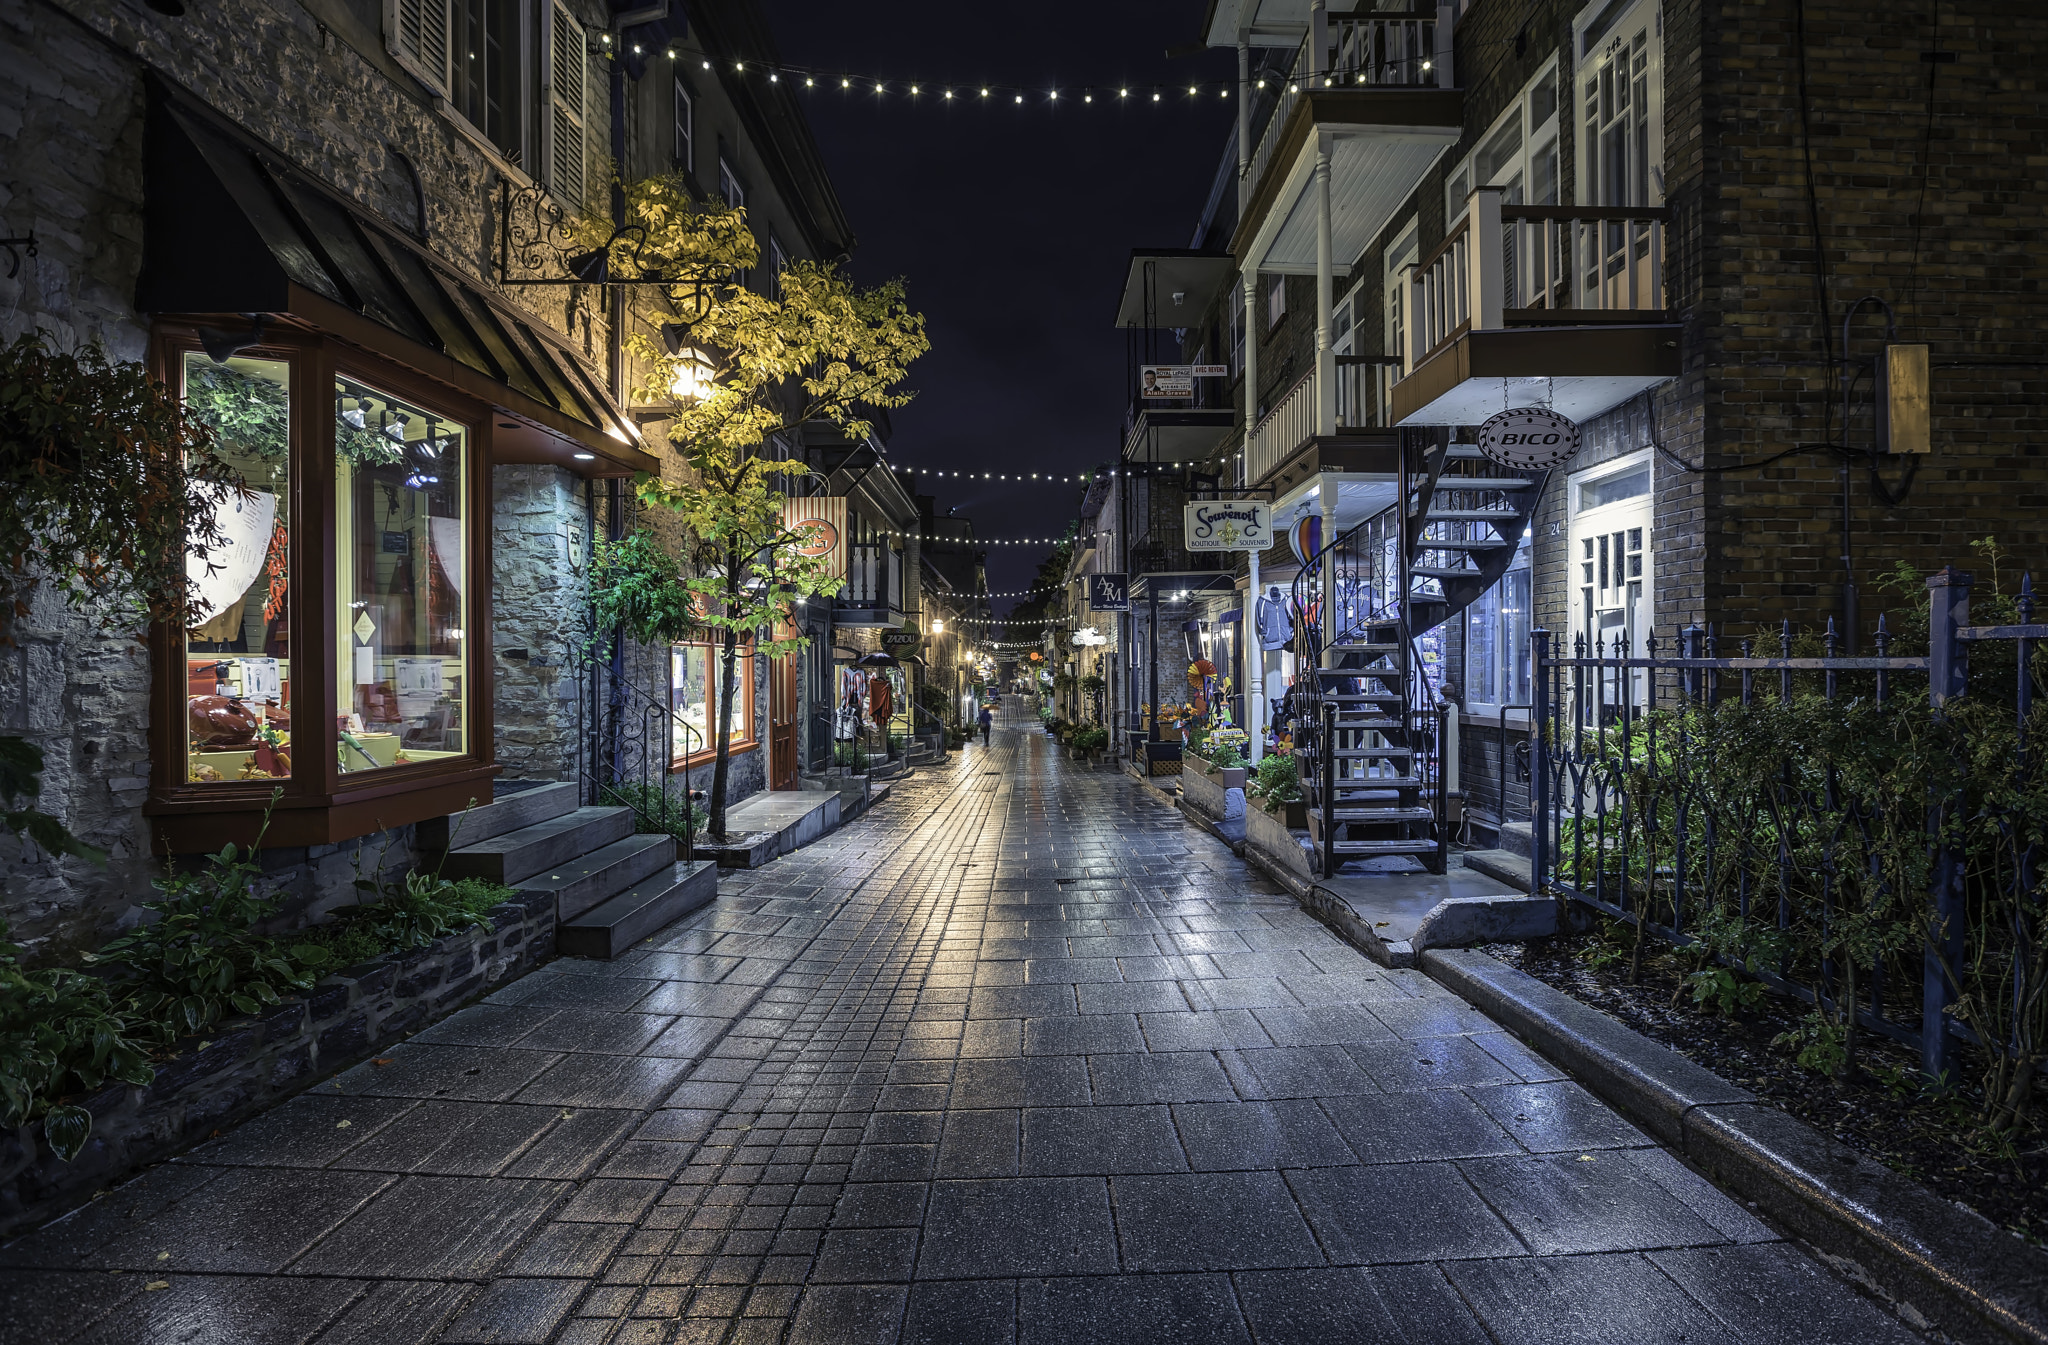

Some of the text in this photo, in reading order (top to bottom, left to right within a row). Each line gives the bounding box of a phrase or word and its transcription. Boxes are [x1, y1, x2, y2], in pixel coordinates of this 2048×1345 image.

[1500, 433, 1561, 445] BICO
[1551, 522, 1560, 536] 24
[886, 634, 915, 644] ZAZOU
